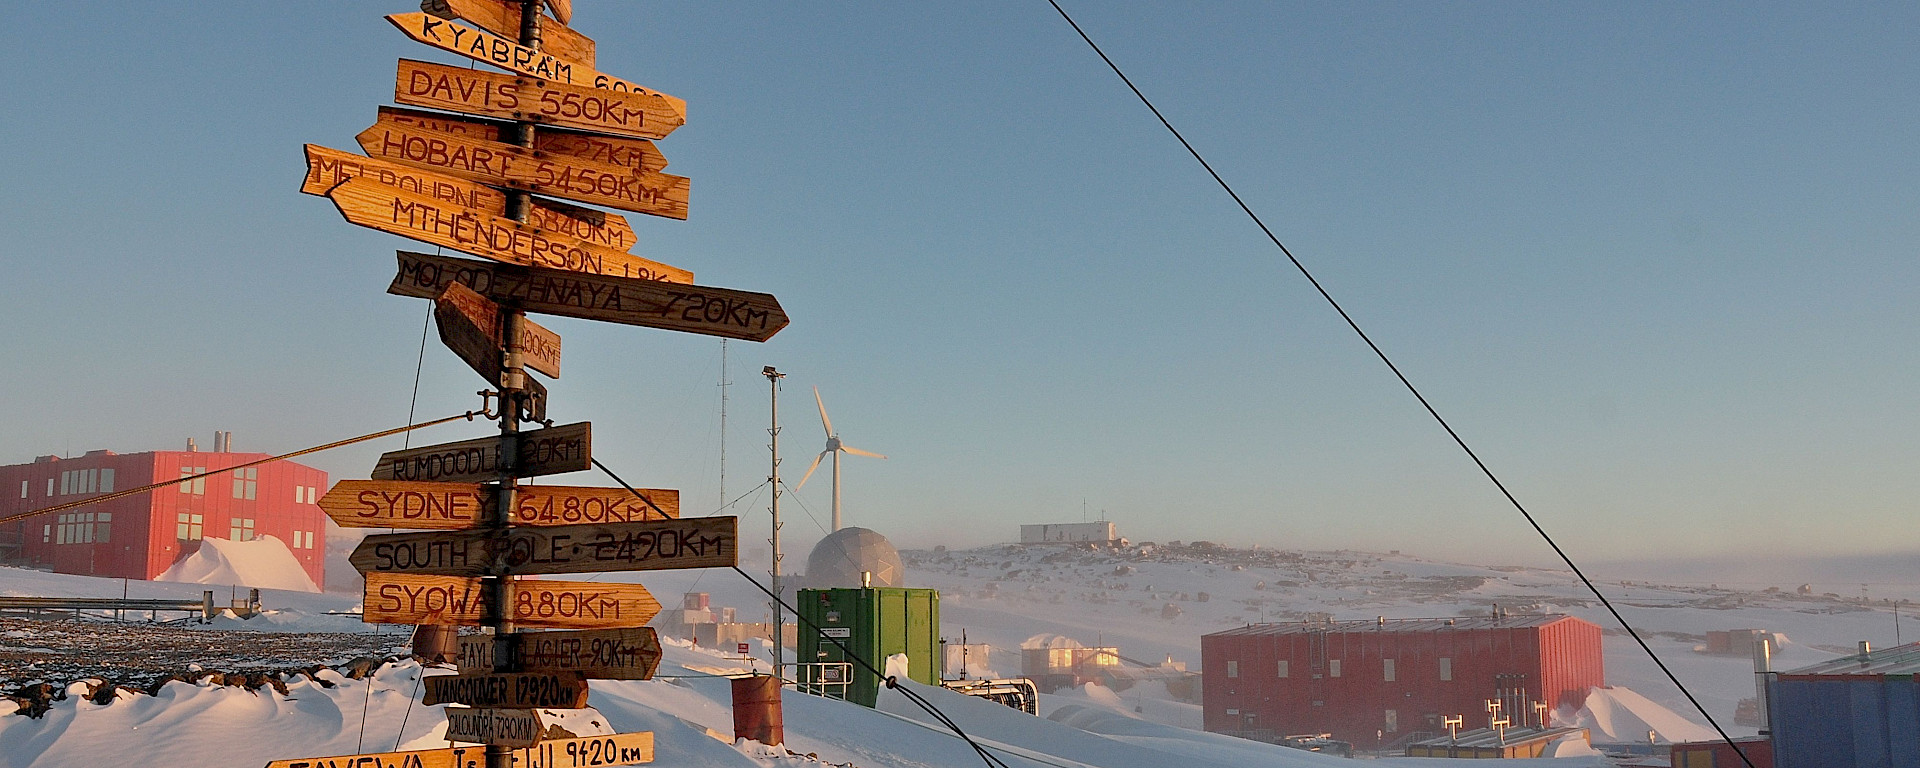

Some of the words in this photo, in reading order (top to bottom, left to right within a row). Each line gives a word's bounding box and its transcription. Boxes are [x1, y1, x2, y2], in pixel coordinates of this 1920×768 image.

[423, 16, 571, 84] KYABRAM
[409, 70, 519, 109] DAVIS
[383, 131, 515, 178] HOBART
[358, 491, 494, 520] SYDNEY
[375, 540, 468, 571] SOUTH
[492, 535, 571, 567] POLE
[378, 584, 491, 615] SYOWA
[435, 676, 508, 706] VANCOUVER
[450, 714, 494, 737] CALOUNDRA
[566, 738, 617, 767] 9420
